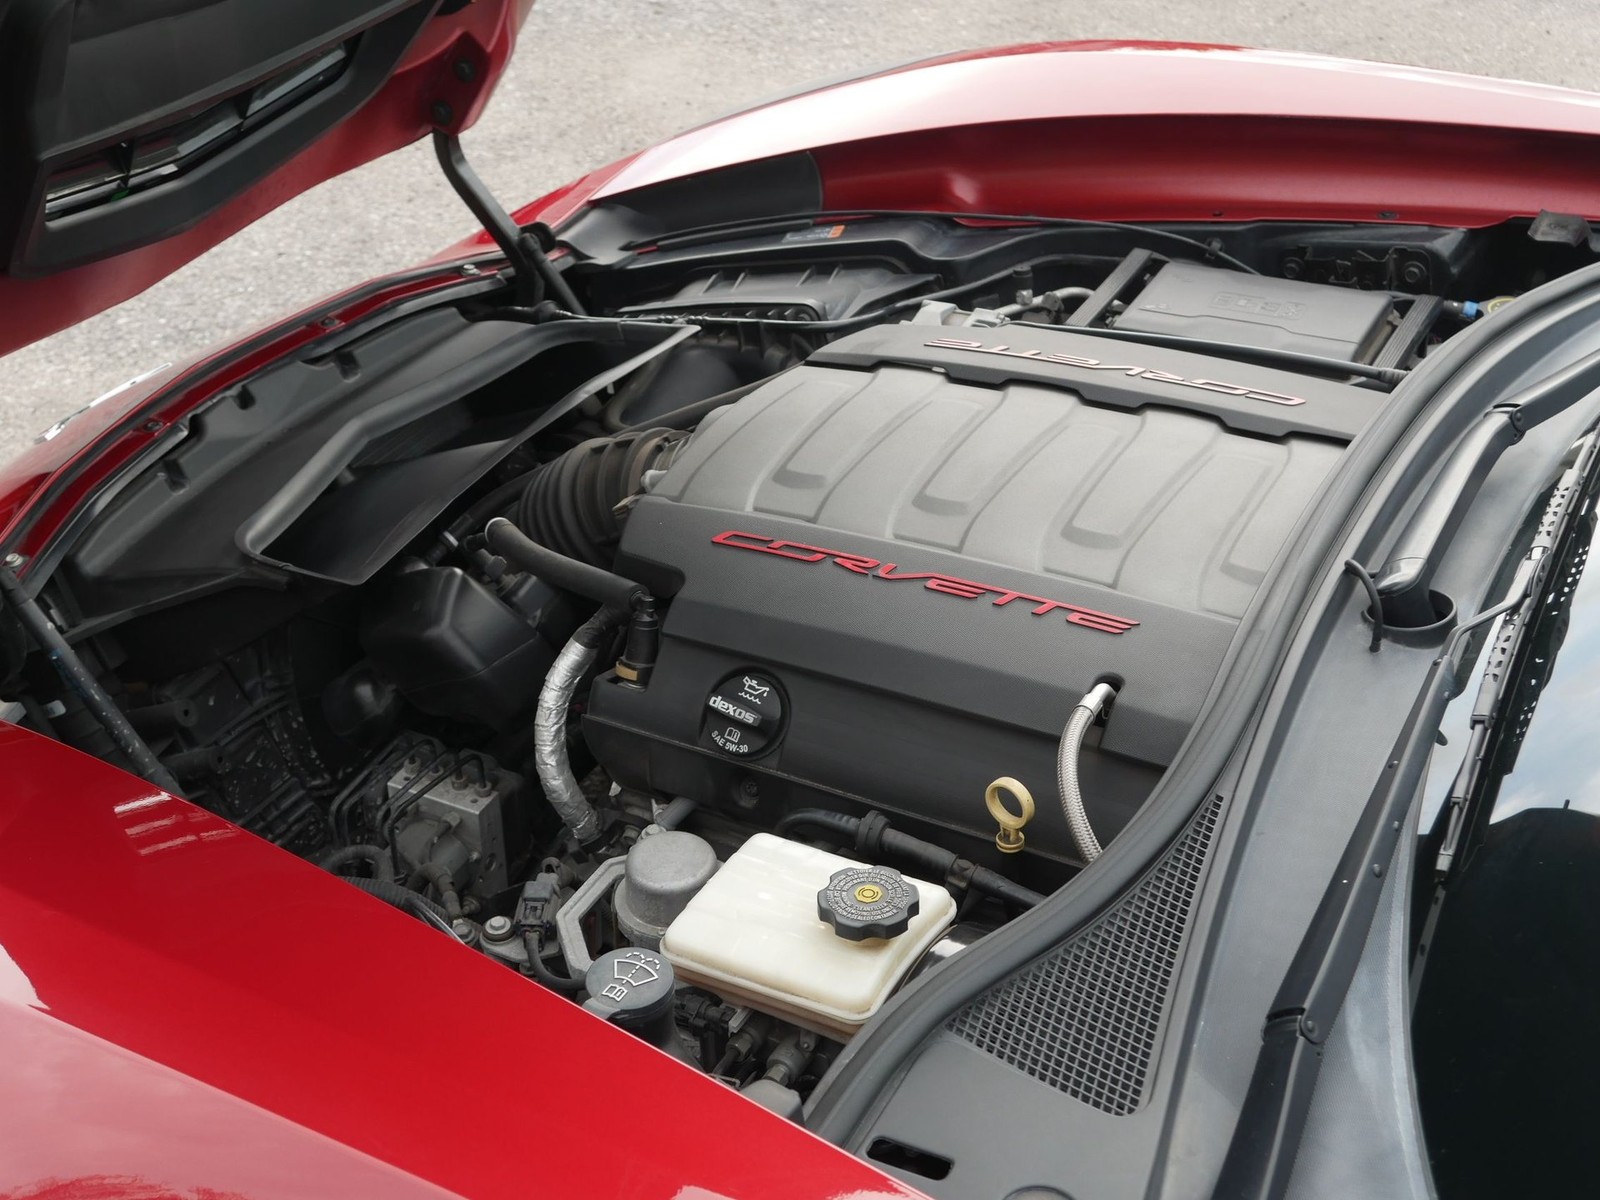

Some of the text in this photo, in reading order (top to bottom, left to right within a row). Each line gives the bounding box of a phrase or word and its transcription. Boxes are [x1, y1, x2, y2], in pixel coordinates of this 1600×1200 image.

[924, 338, 1306, 406] CORVETTE
[711, 530, 1140, 635] CORVETTE
[709, 695, 758, 724] dexos
[711, 730, 749, 753] SAE 5W-30
